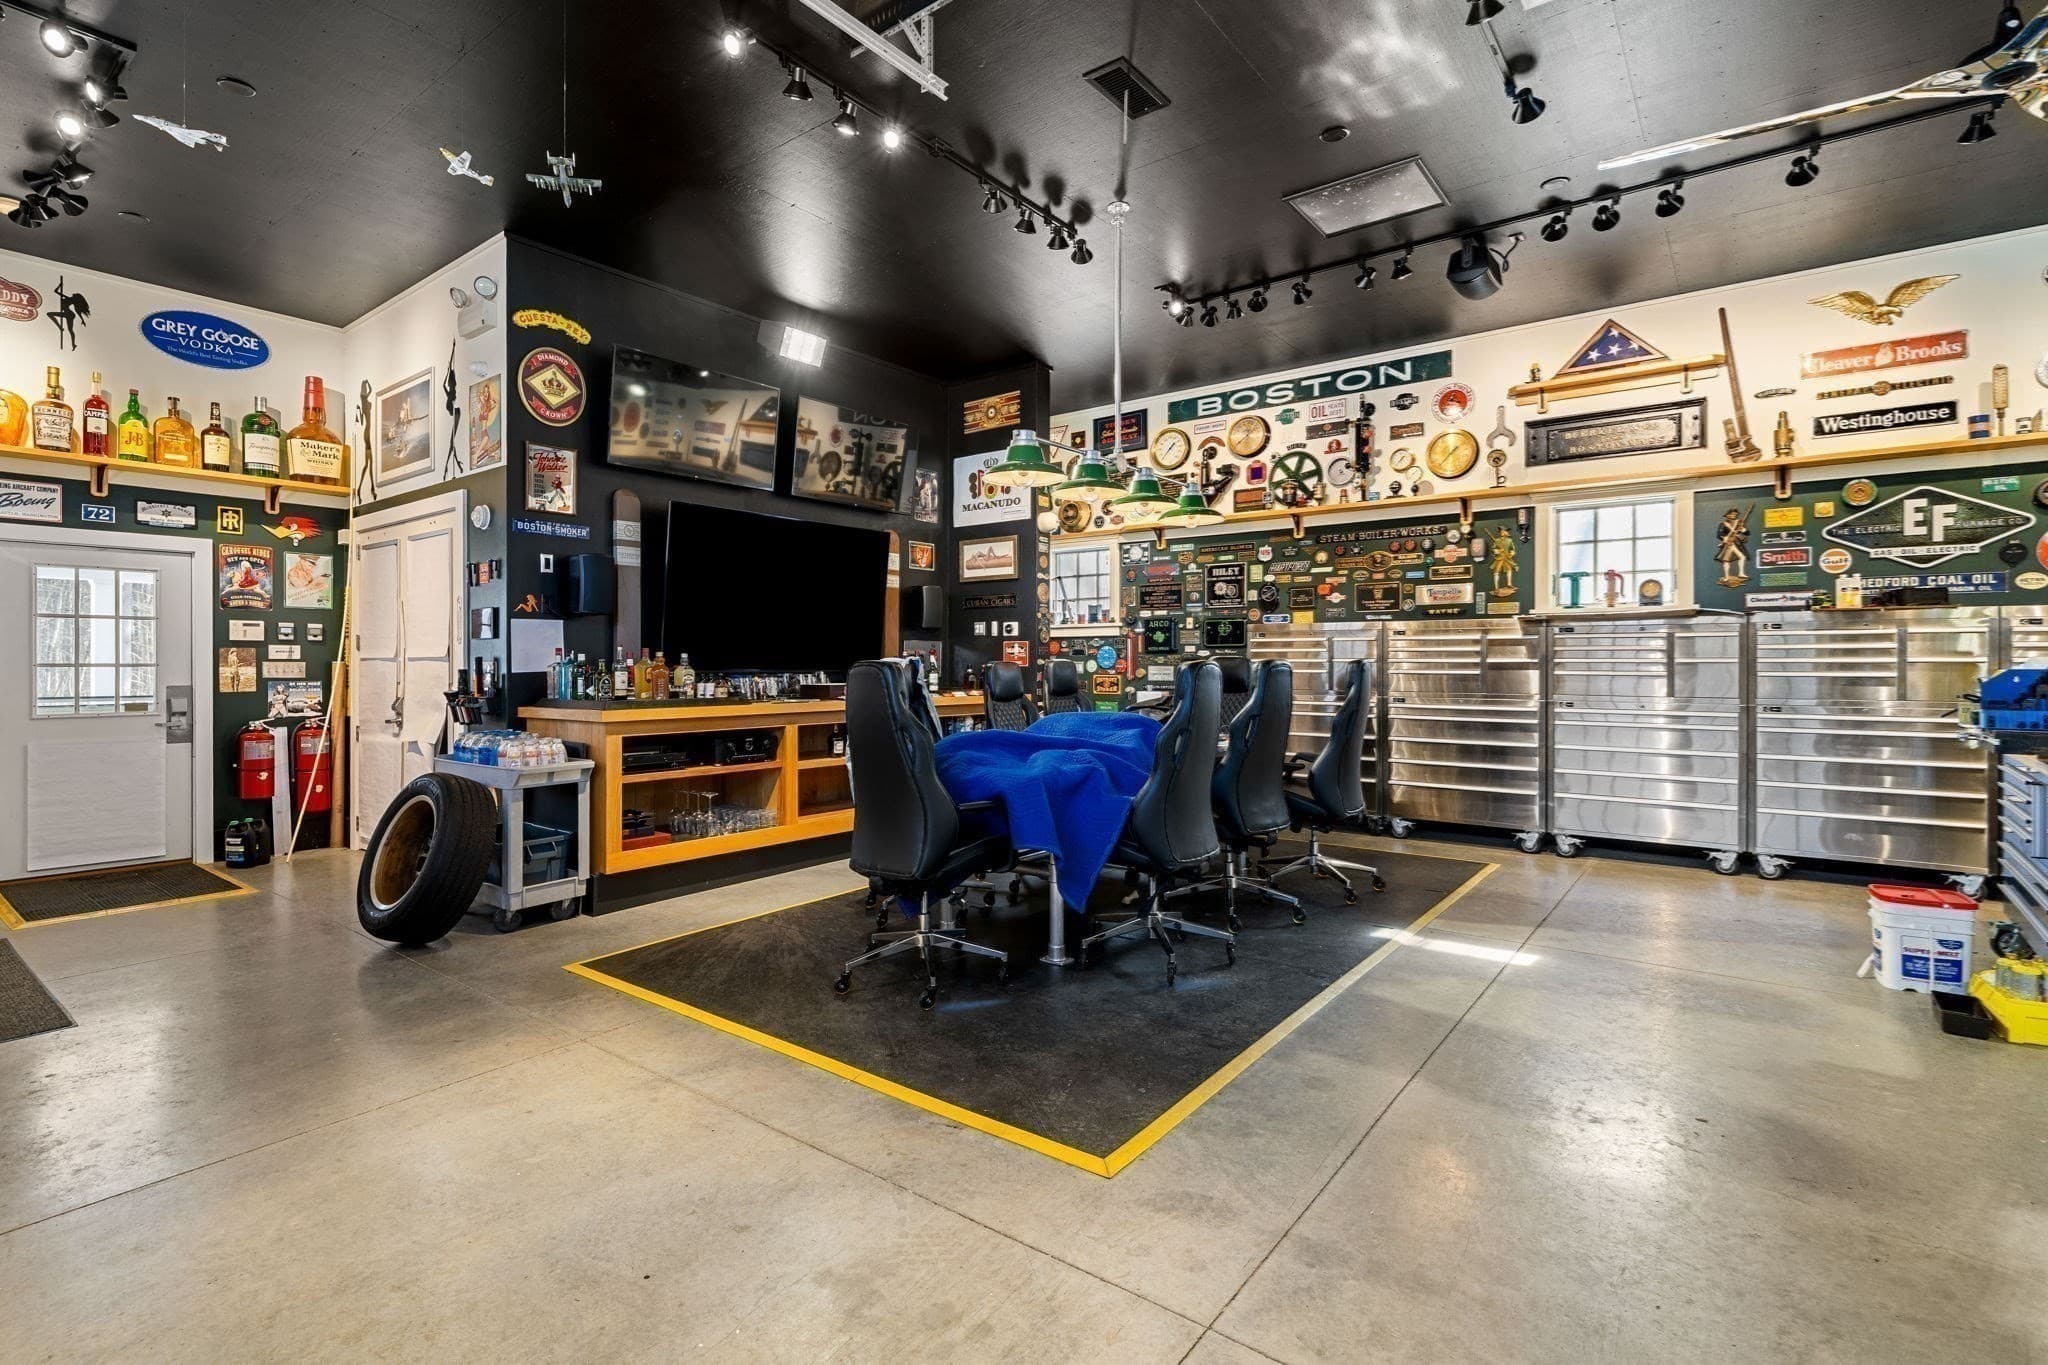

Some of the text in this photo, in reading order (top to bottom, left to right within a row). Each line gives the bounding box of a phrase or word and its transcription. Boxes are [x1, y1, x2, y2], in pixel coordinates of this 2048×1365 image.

[152, 318, 260, 351] GREY GOOSE
[179, 337, 235, 356] VODKA
[538, 353, 569, 367] DIAMOND
[1803, 341, 1963, 373] Cleaver Brooks
[1197, 360, 1412, 417] BOSTON
[540, 407, 568, 418] CROWN
[1311, 405, 1328, 418] OIL
[1819, 407, 1950, 433] Westinghouse
[300, 441, 340, 452] Maker's
[312, 450, 340, 460] Mark
[533, 452, 567, 466] Johnnie
[534, 462, 568, 472] Walker
[0, 492, 56, 509] Boeing
[962, 497, 1021, 512] MACANUDO
[88, 507, 110, 520] 72
[1855, 523, 1901, 534] ELECTRIC
[1954, 518, 2004, 528] FURNACE
[1320, 527, 1440, 543] STEAM BOILER WORKS
[1926, 545, 1977, 553] ELECTRIC
[1762, 551, 1807, 562] Smith
[1212, 567, 1240, 577] RILEY
[1927, 574, 1966, 586] COAL
[1971, 573, 1998, 584] OIL
[990, 597, 1016, 607] CIGARS
[1148, 620, 1170, 628] ARCO
